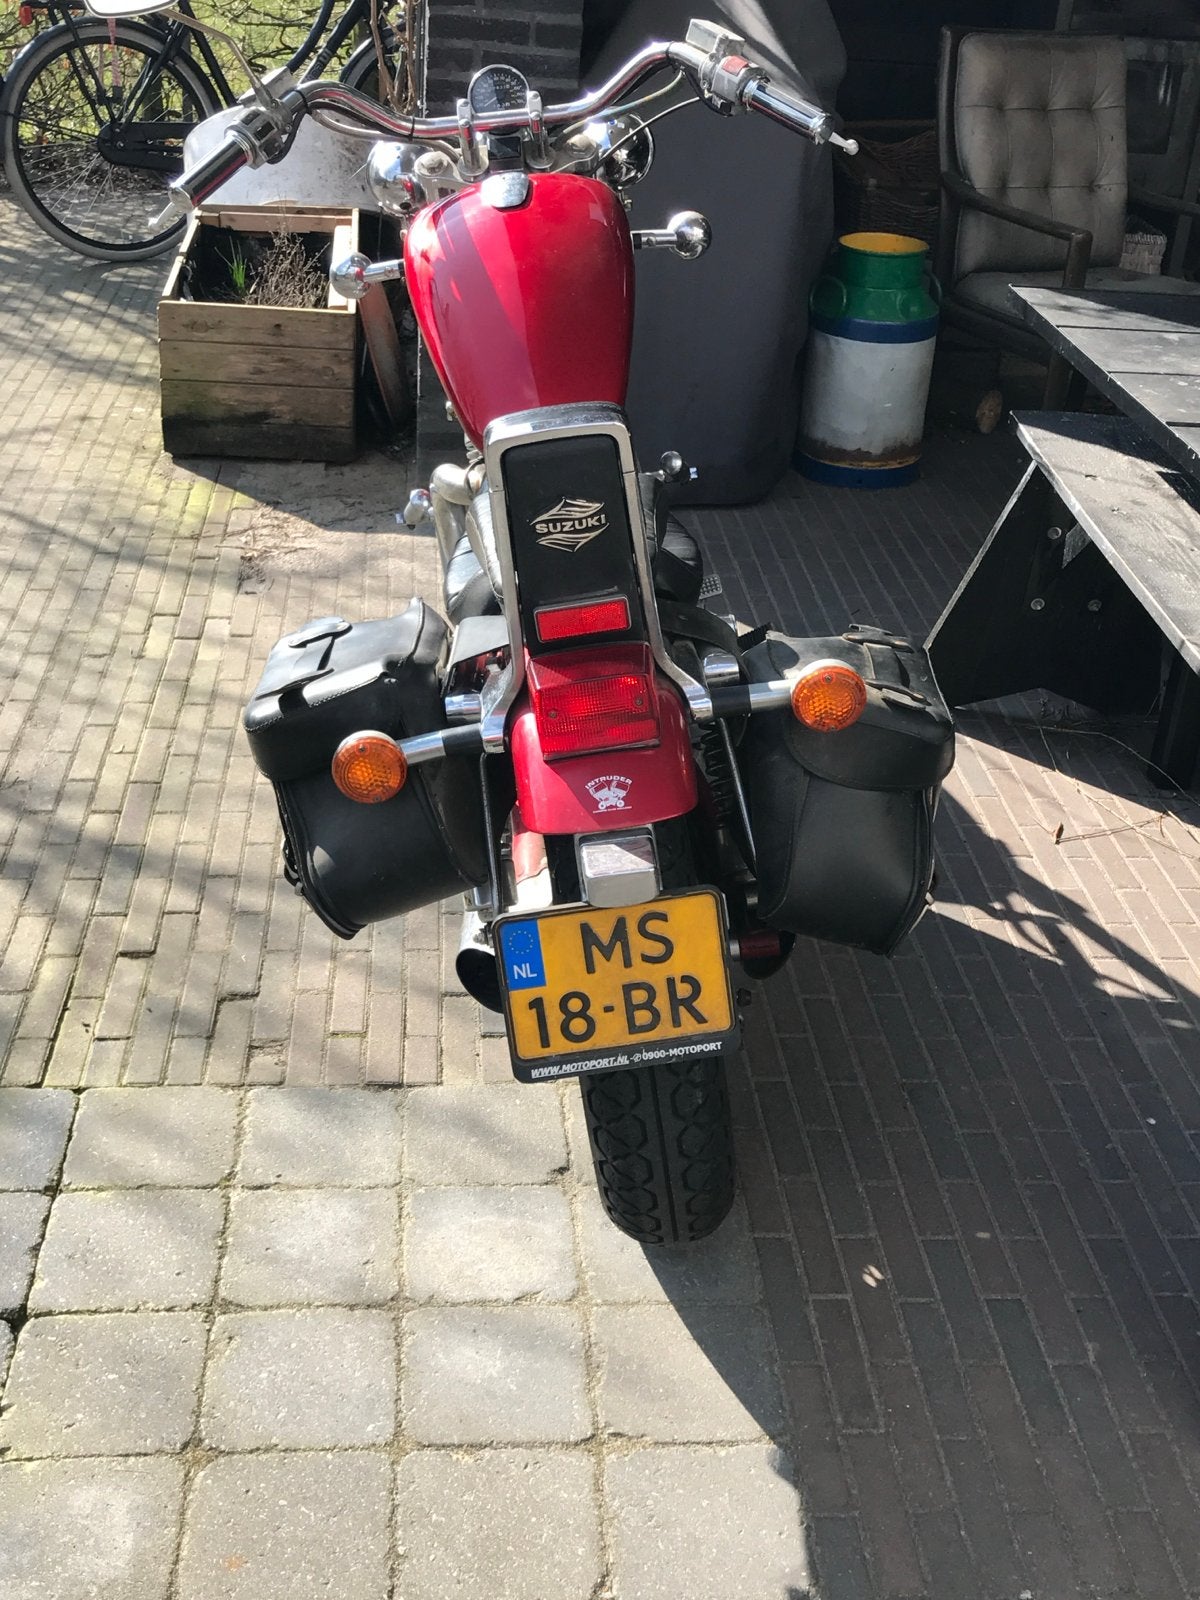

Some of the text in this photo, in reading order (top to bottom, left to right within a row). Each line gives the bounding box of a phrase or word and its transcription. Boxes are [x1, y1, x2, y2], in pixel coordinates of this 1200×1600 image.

[535, 514, 606, 534] SUZUKI
[585, 775, 633, 790] INTRUDER
[580, 912, 675, 974] MS
[513, 963, 538, 980] NL
[528, 975, 709, 1049] 18-BR
